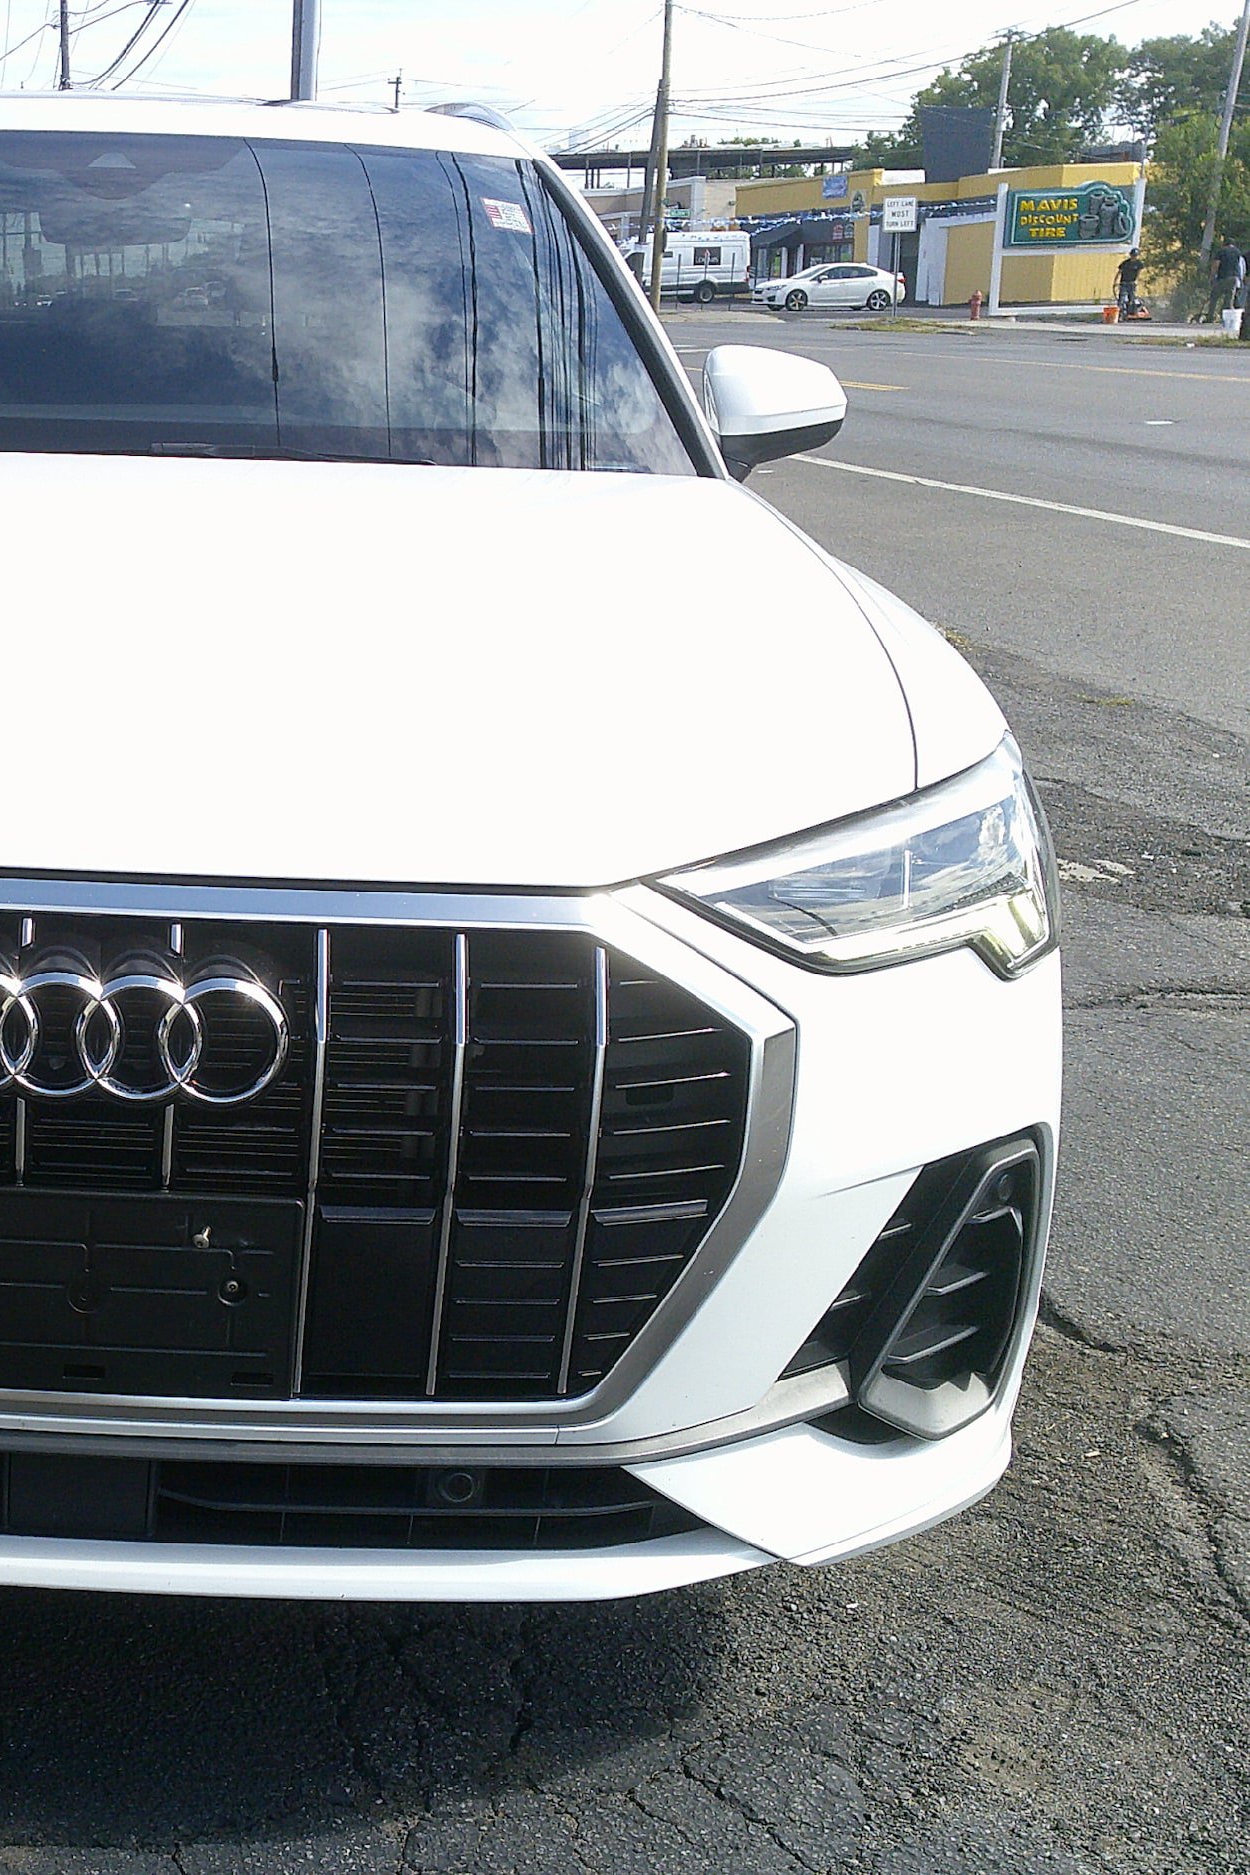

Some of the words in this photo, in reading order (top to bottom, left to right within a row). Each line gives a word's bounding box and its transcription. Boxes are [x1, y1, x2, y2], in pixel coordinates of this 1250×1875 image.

[1020, 199, 1078, 211] MAVIS
[1020, 214, 1080, 226] DISCOUNT
[1029, 227, 1067, 238] TIRE
